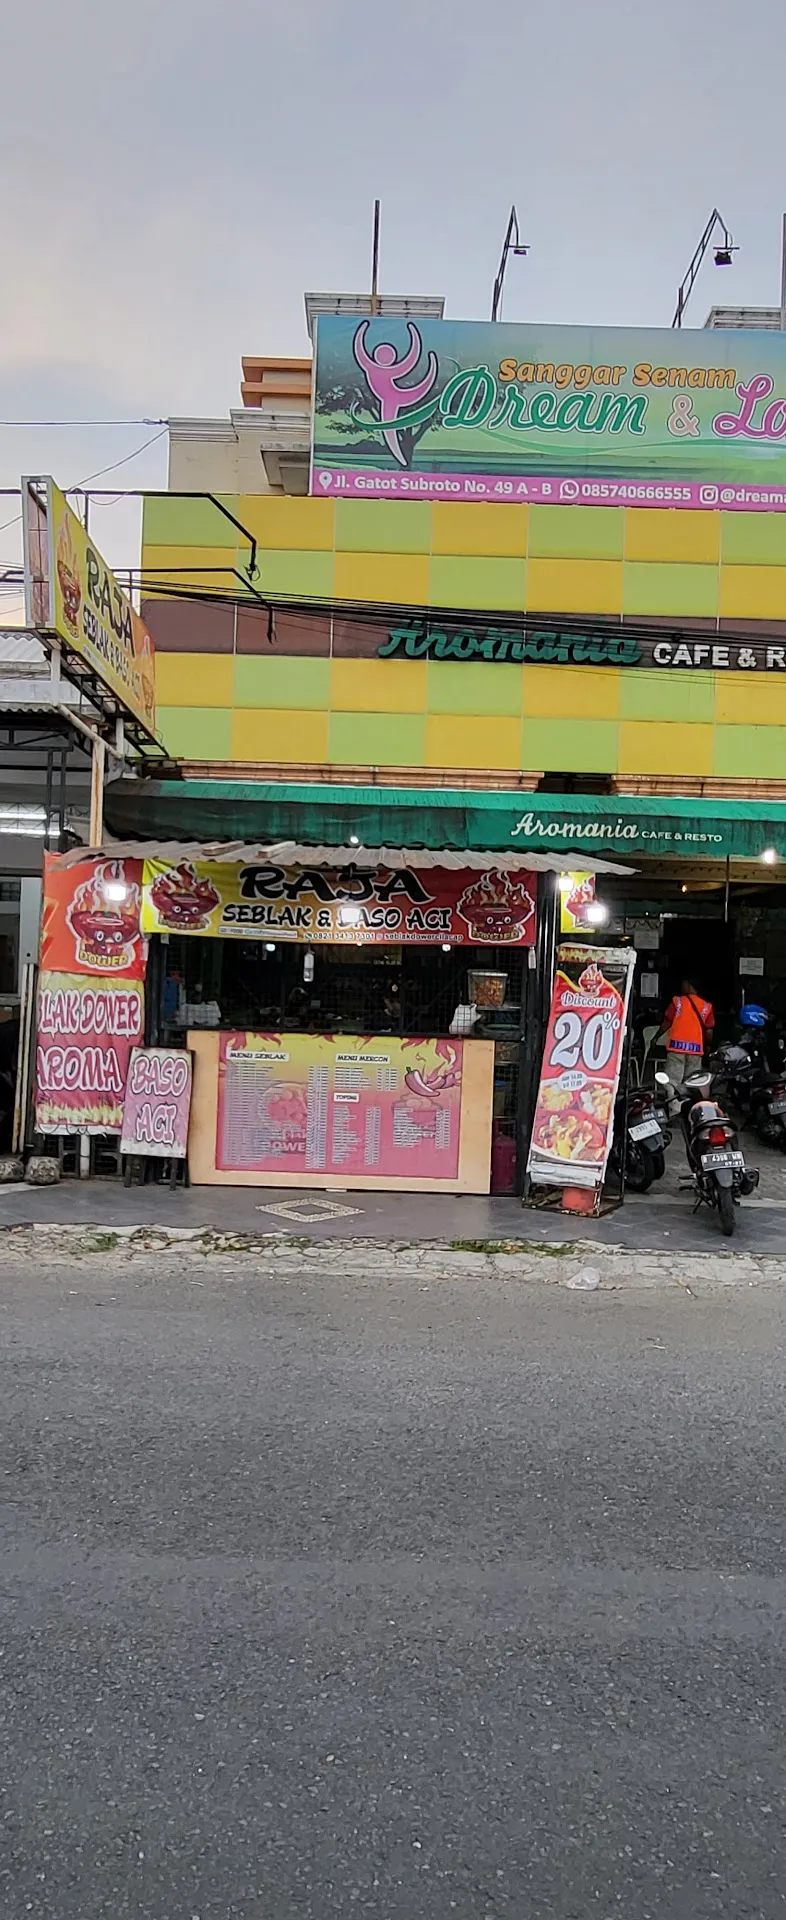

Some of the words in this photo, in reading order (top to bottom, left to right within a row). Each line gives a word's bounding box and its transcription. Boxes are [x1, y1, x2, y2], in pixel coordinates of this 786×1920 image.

[499, 358, 625, 390] Sanggar
[632, 362, 737, 389] Senam
[439, 364, 649, 436] Dream
[667, 394, 700, 437] &
[334, 475, 350, 488] Jl.
[354, 475, 397, 491] Gatot
[400, 477, 460, 493] Subroto
[464, 480, 490, 494] No.
[494, 481, 513, 495] 49
[516, 482, 528, 495] A
[542, 483, 553, 496] B
[581, 483, 691, 501] 085740666555
[86, 546, 136, 659] RAJA
[82, 602, 110, 663] SEBLAK
[377, 618, 643, 665] Aromania
[653, 642, 730, 667] CAFE
[737, 647, 757, 668] &
[510, 812, 640, 840] Aromania
[641, 830, 671, 840] CAFE
[675, 832, 682, 841] &
[685, 832, 722, 843] RESTO
[238, 865, 438, 904] RAJA
[222, 903, 312, 928] SEBLAK
[316, 909, 332, 928] &
[338, 907, 402, 931] ASO
[406, 908, 453, 931] ACI
[313, 931, 332, 940] 0821
[80, 989, 140, 1036] DOWER
[561, 990, 616, 1008] Discount
[549, 1010, 615, 1071] 20
[603, 1011, 620, 1030] %
[131, 1056, 187, 1097] BASO
[136, 1103, 177, 1144] ACI
